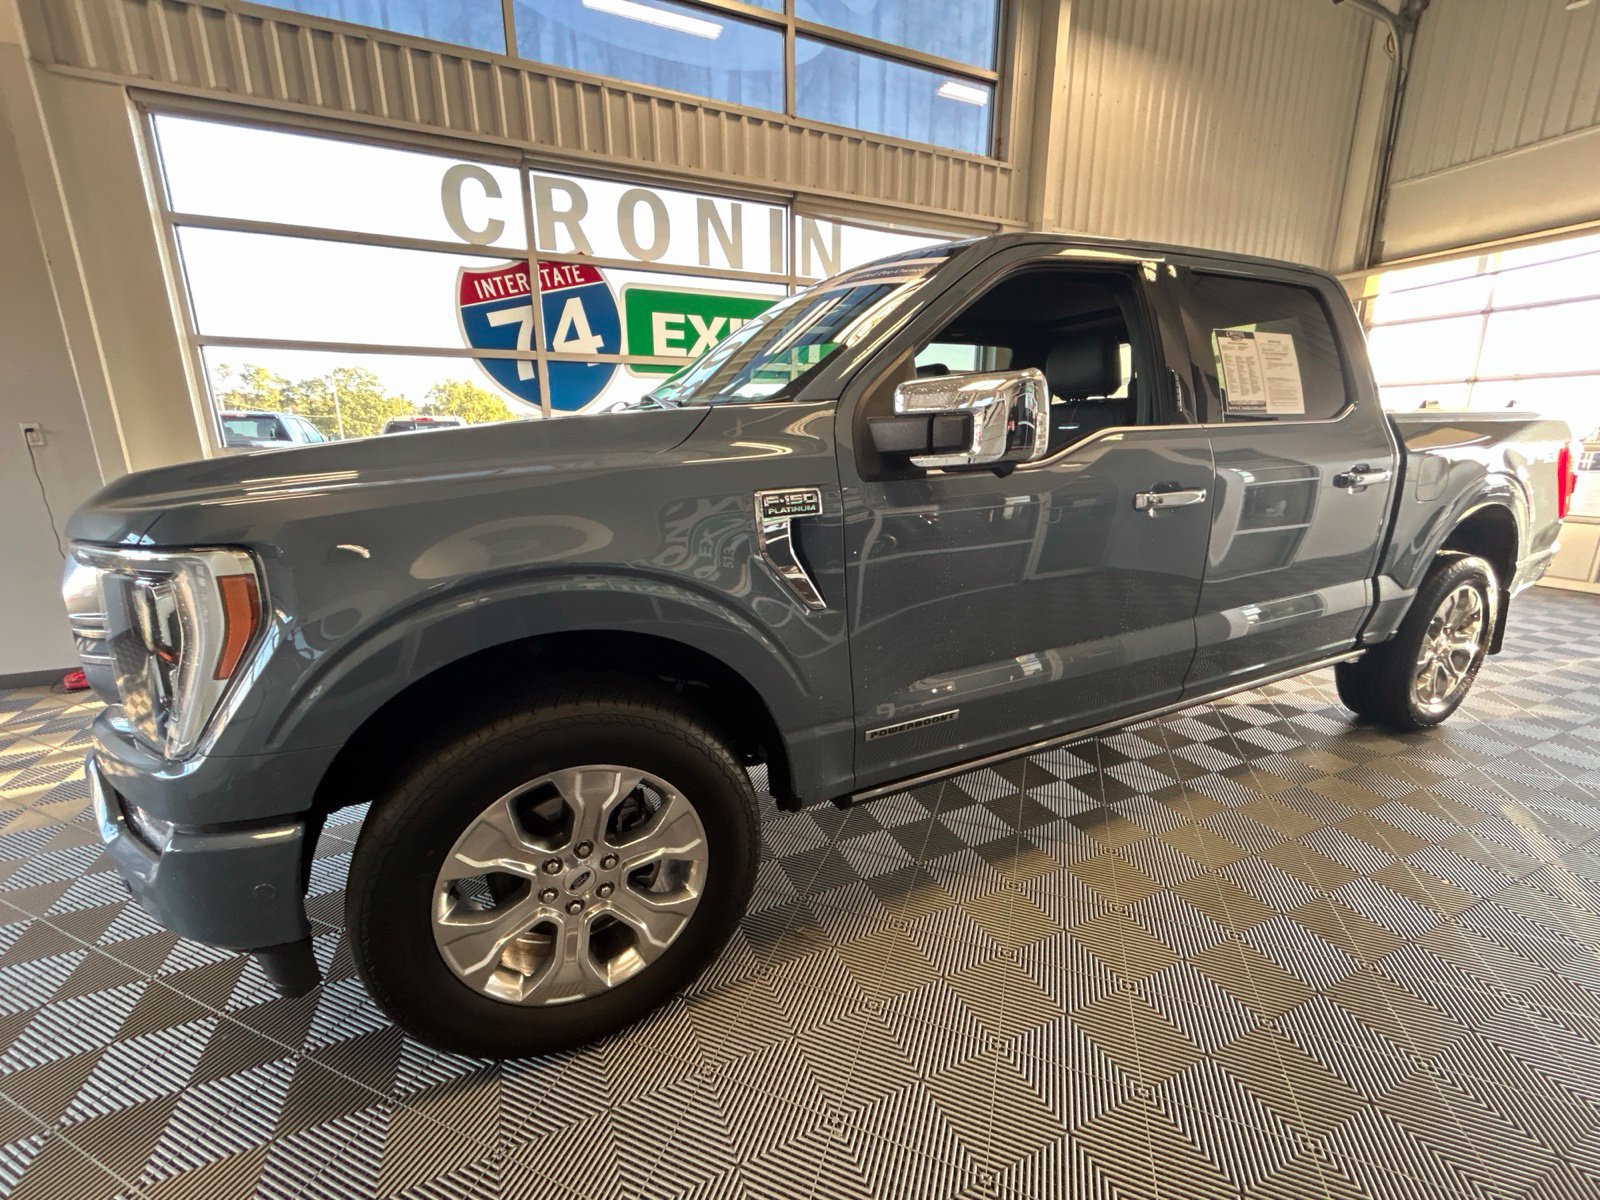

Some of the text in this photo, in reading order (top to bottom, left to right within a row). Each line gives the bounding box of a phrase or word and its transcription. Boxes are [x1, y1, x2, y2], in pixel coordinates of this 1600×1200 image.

[441, 163, 842, 280] CRONIN
[473, 264, 585, 300] INTERTATE
[486, 296, 605, 382] 74
[763, 493, 818, 507] F-150
[767, 504, 817, 515] PLATINUM
[870, 712, 956, 739] POWERBOOST
